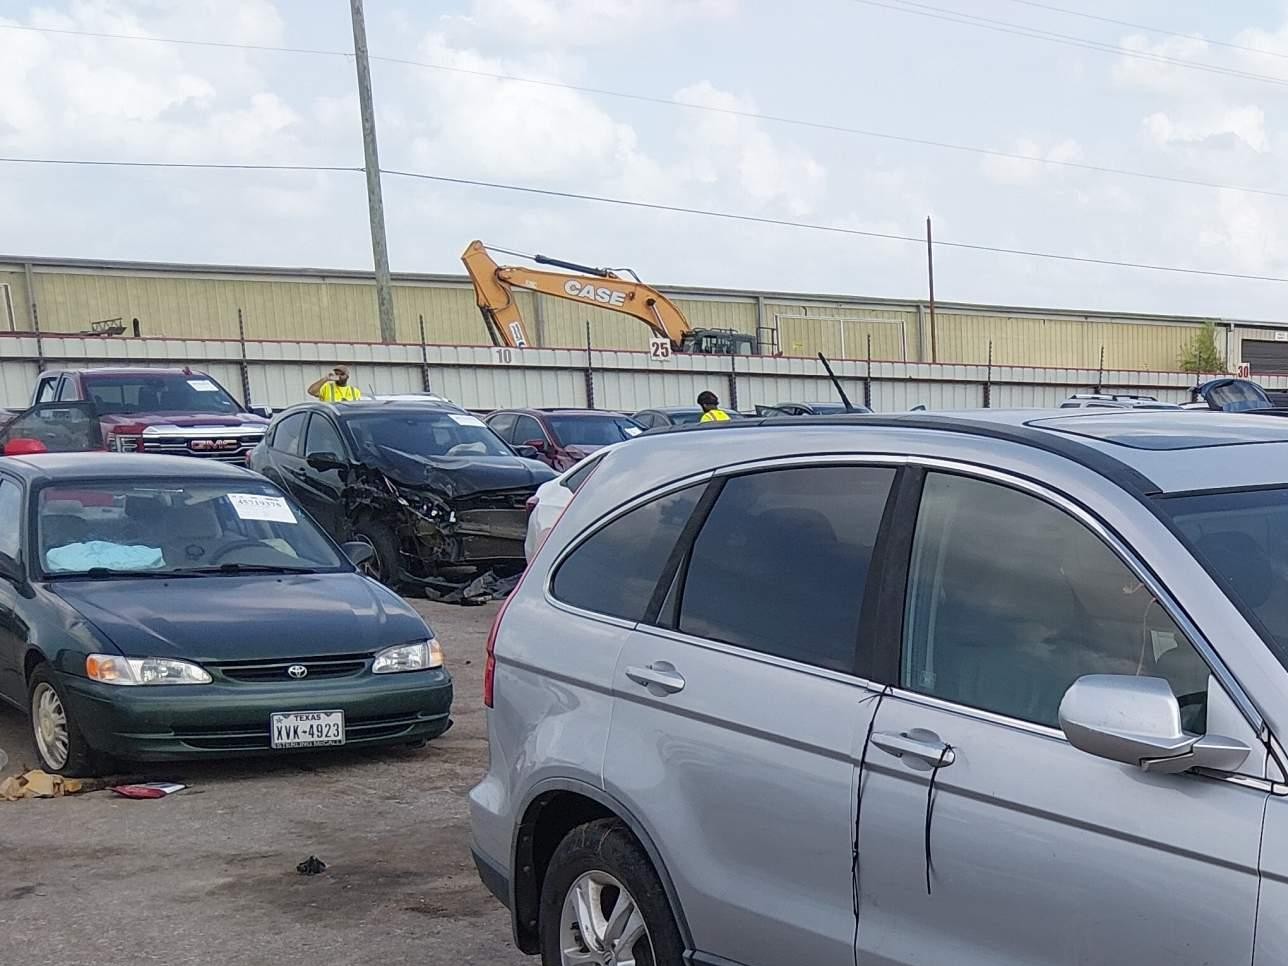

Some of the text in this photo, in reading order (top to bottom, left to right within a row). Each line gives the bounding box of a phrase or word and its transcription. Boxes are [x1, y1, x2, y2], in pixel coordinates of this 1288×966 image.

[564, 279, 625, 306] CASE
[496, 349, 512, 364] 10
[651, 342, 669, 358] 25
[1238, 366, 1248, 377] 30
[191, 439, 238, 450] GMC
[276, 723, 340, 741] XVK-4923
